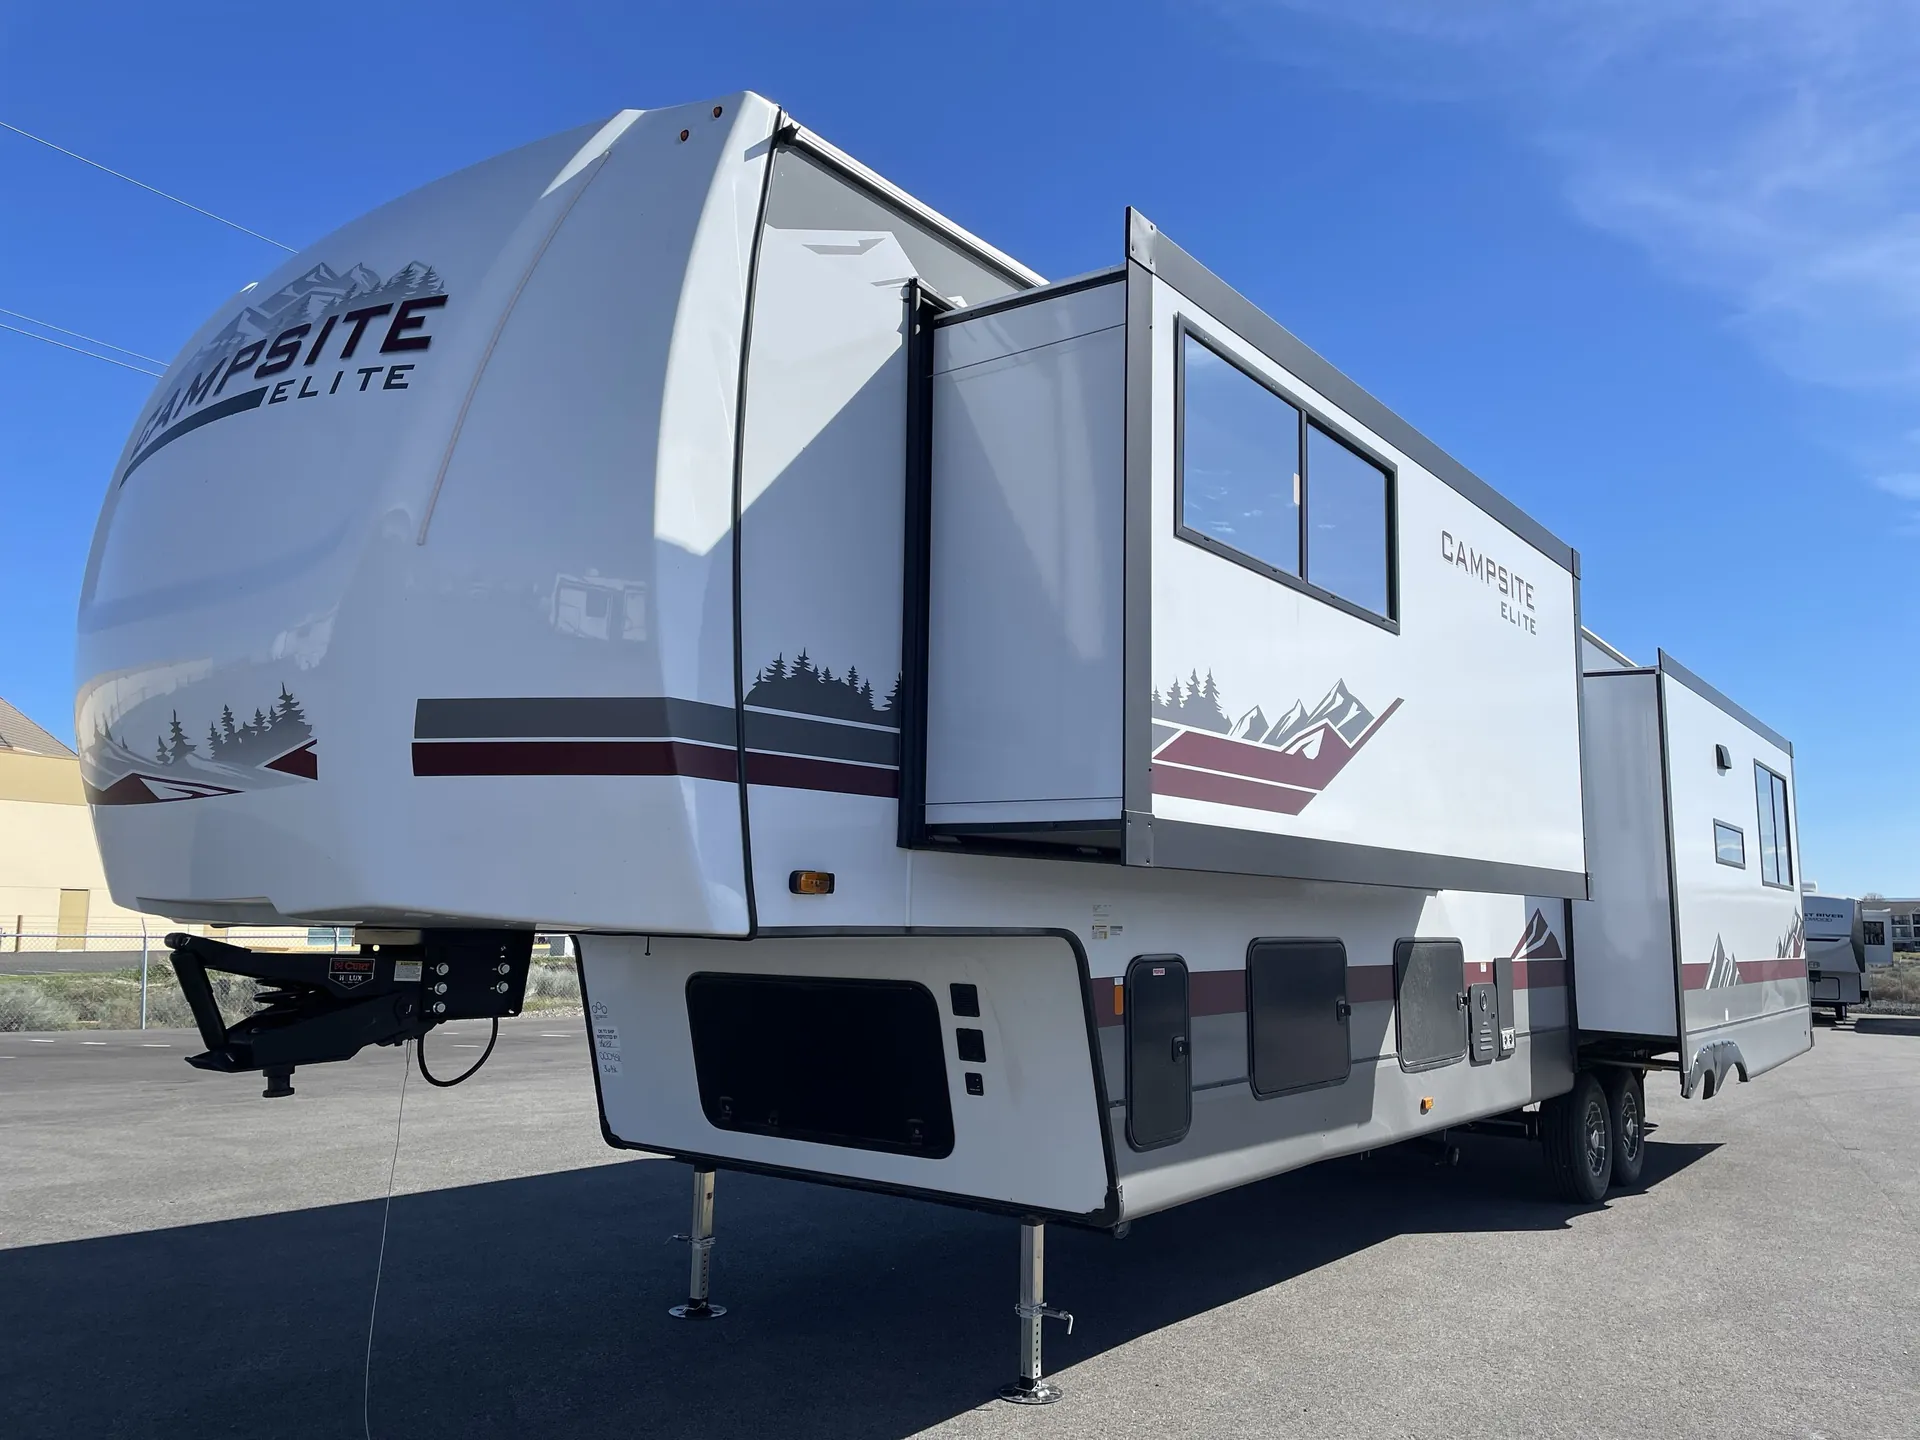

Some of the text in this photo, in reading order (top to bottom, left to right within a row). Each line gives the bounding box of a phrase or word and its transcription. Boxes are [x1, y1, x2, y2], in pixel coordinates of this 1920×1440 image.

[129, 294, 449, 462] CAMPSITE
[267, 364, 416, 405] ELITE
[1441, 530, 1535, 611] CAMPSITE
[1501, 601, 1537, 636] ELITE
